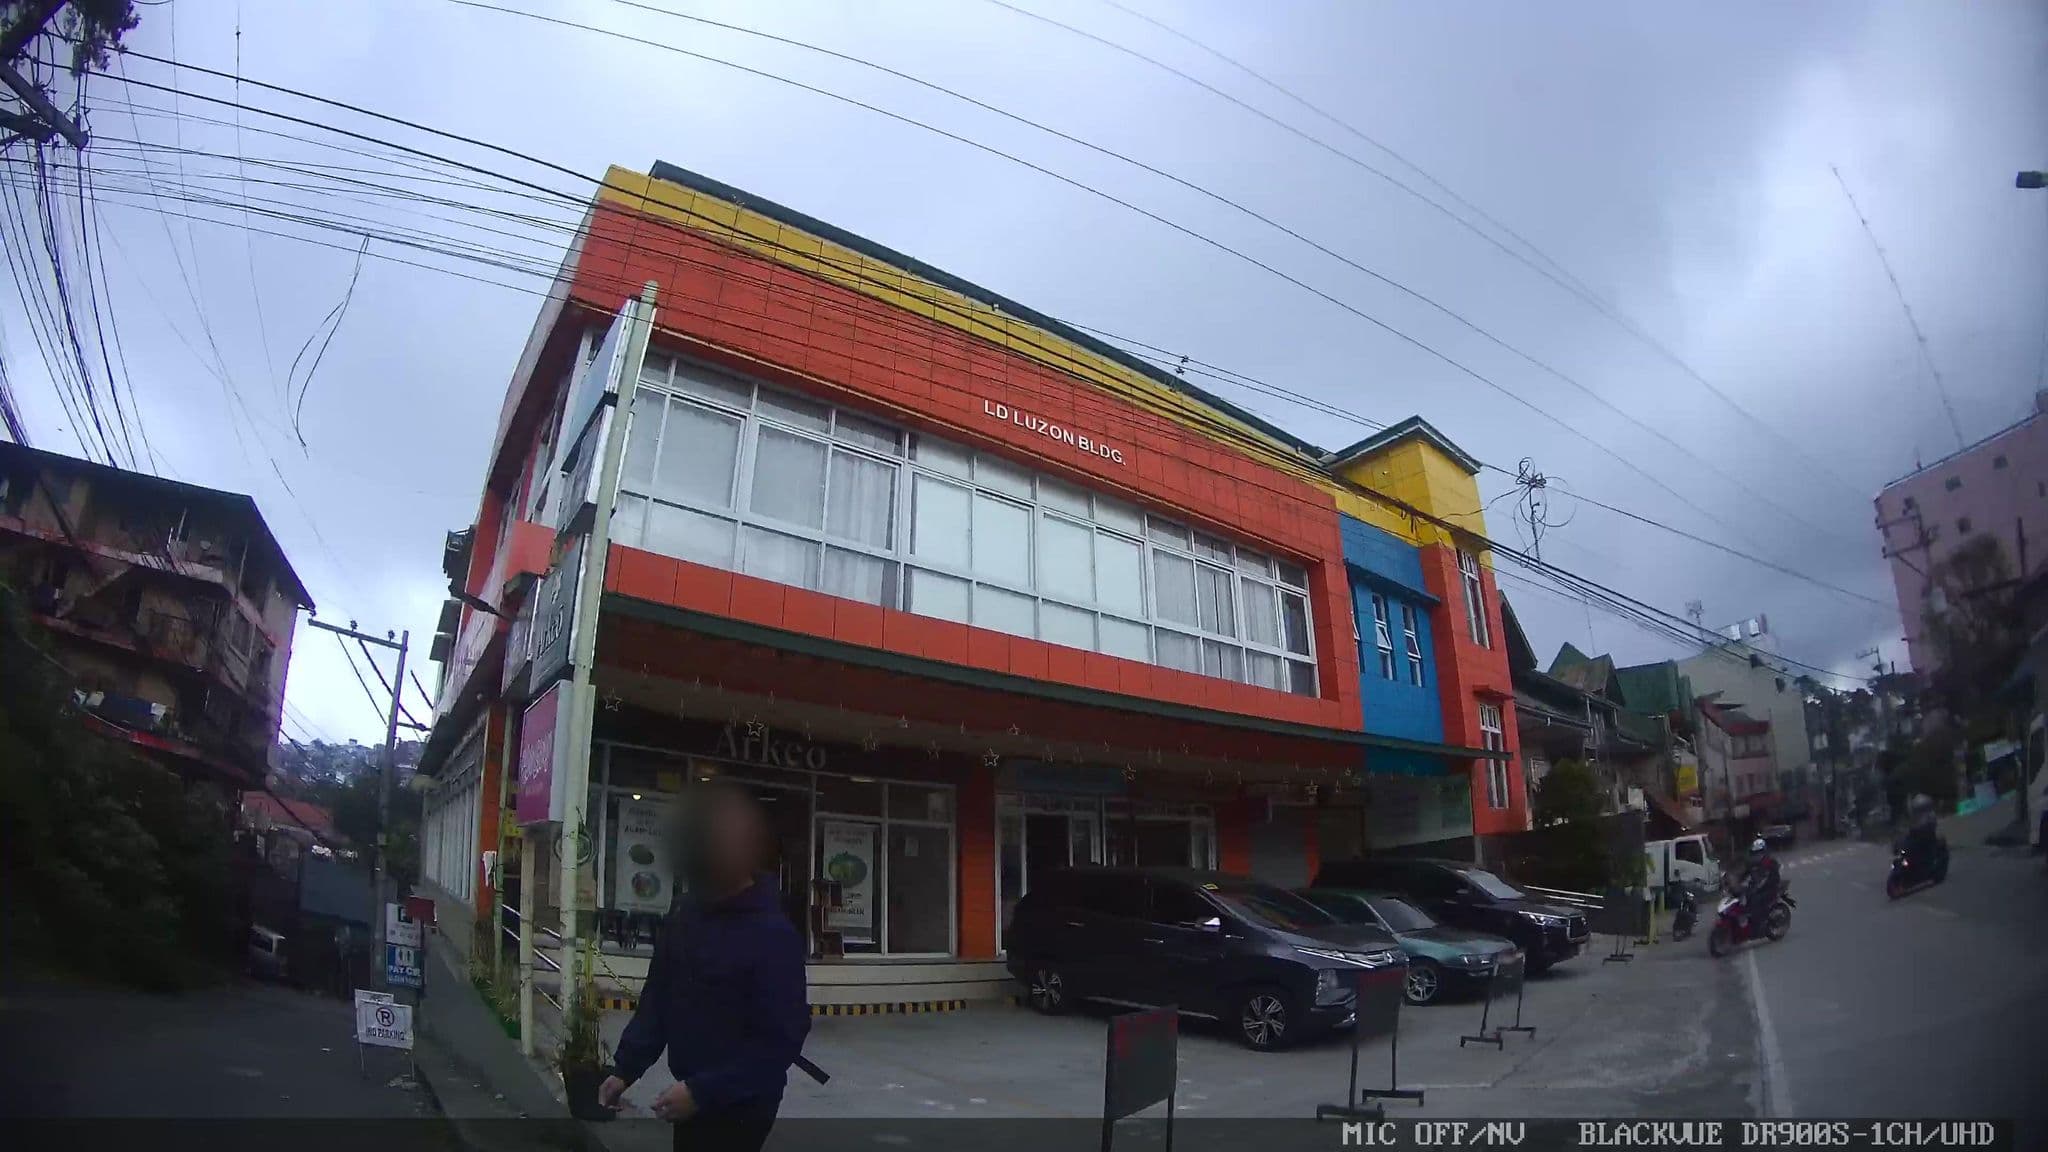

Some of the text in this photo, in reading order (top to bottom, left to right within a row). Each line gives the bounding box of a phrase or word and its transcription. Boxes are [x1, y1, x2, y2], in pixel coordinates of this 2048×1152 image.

[984, 399, 1127, 466] LD LUZON BLDG.
